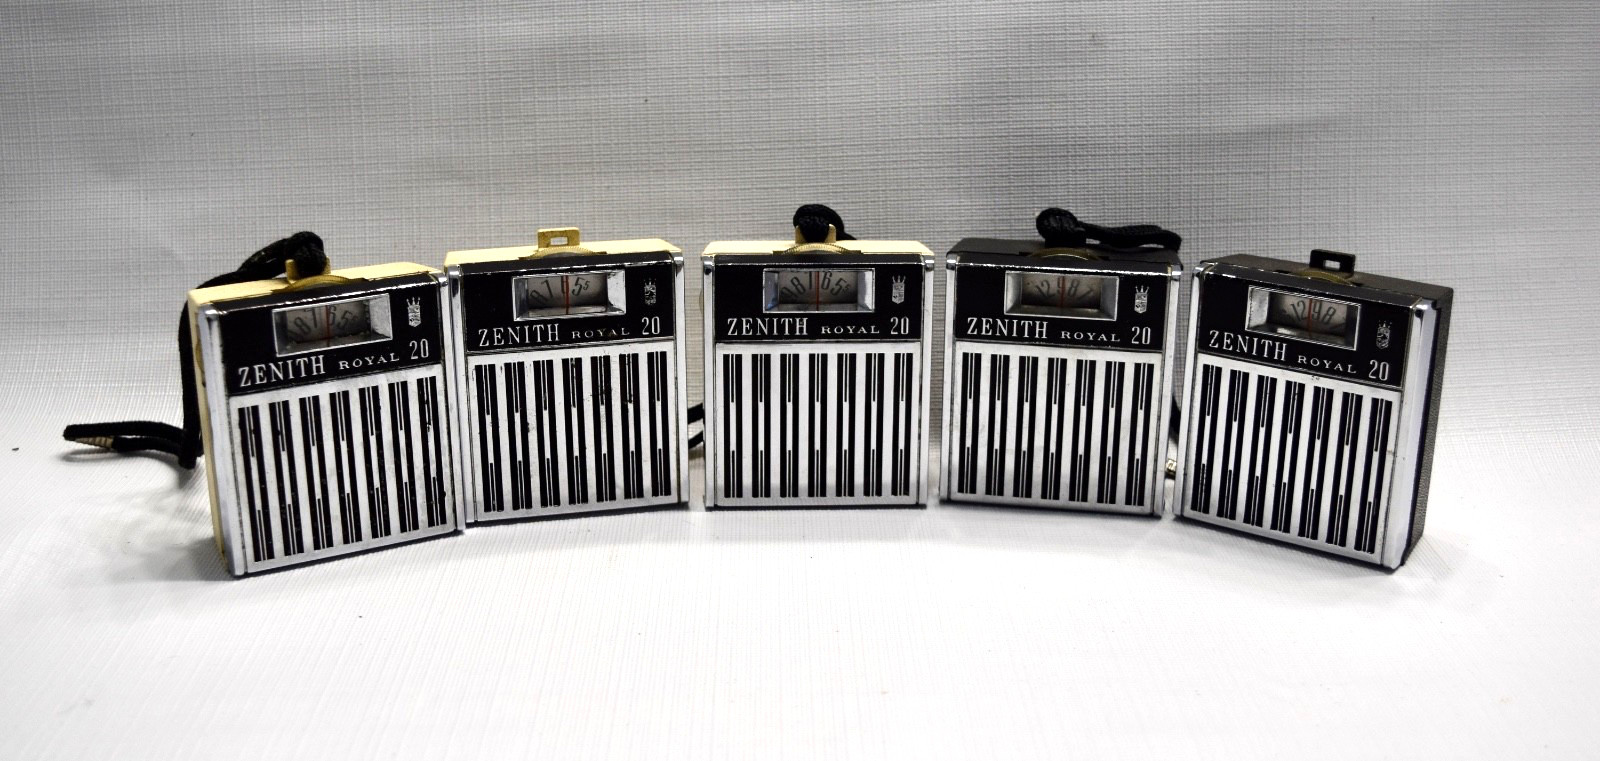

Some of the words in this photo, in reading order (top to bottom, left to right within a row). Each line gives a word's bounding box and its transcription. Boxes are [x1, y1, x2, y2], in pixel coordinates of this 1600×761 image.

[478, 323, 560, 347] ZENITH
[571, 328, 630, 339] ROYAL
[641, 316, 660, 335] 20
[727, 317, 809, 335] ZENITH
[821, 325, 880, 334] ROYAL
[890, 316, 909, 334] 20
[966, 317, 1049, 339] ZENITH
[1060, 330, 1121, 342] ROYAL
[1131, 326, 1150, 345] 20
[238, 355, 325, 387] ZENITH
[339, 352, 400, 370] ROYAL
[409, 338, 429, 360] 20
[1209, 330, 1287, 362] ZENITH
[1297, 355, 1357, 374] ROYAL
[1368, 359, 1389, 381] 20
